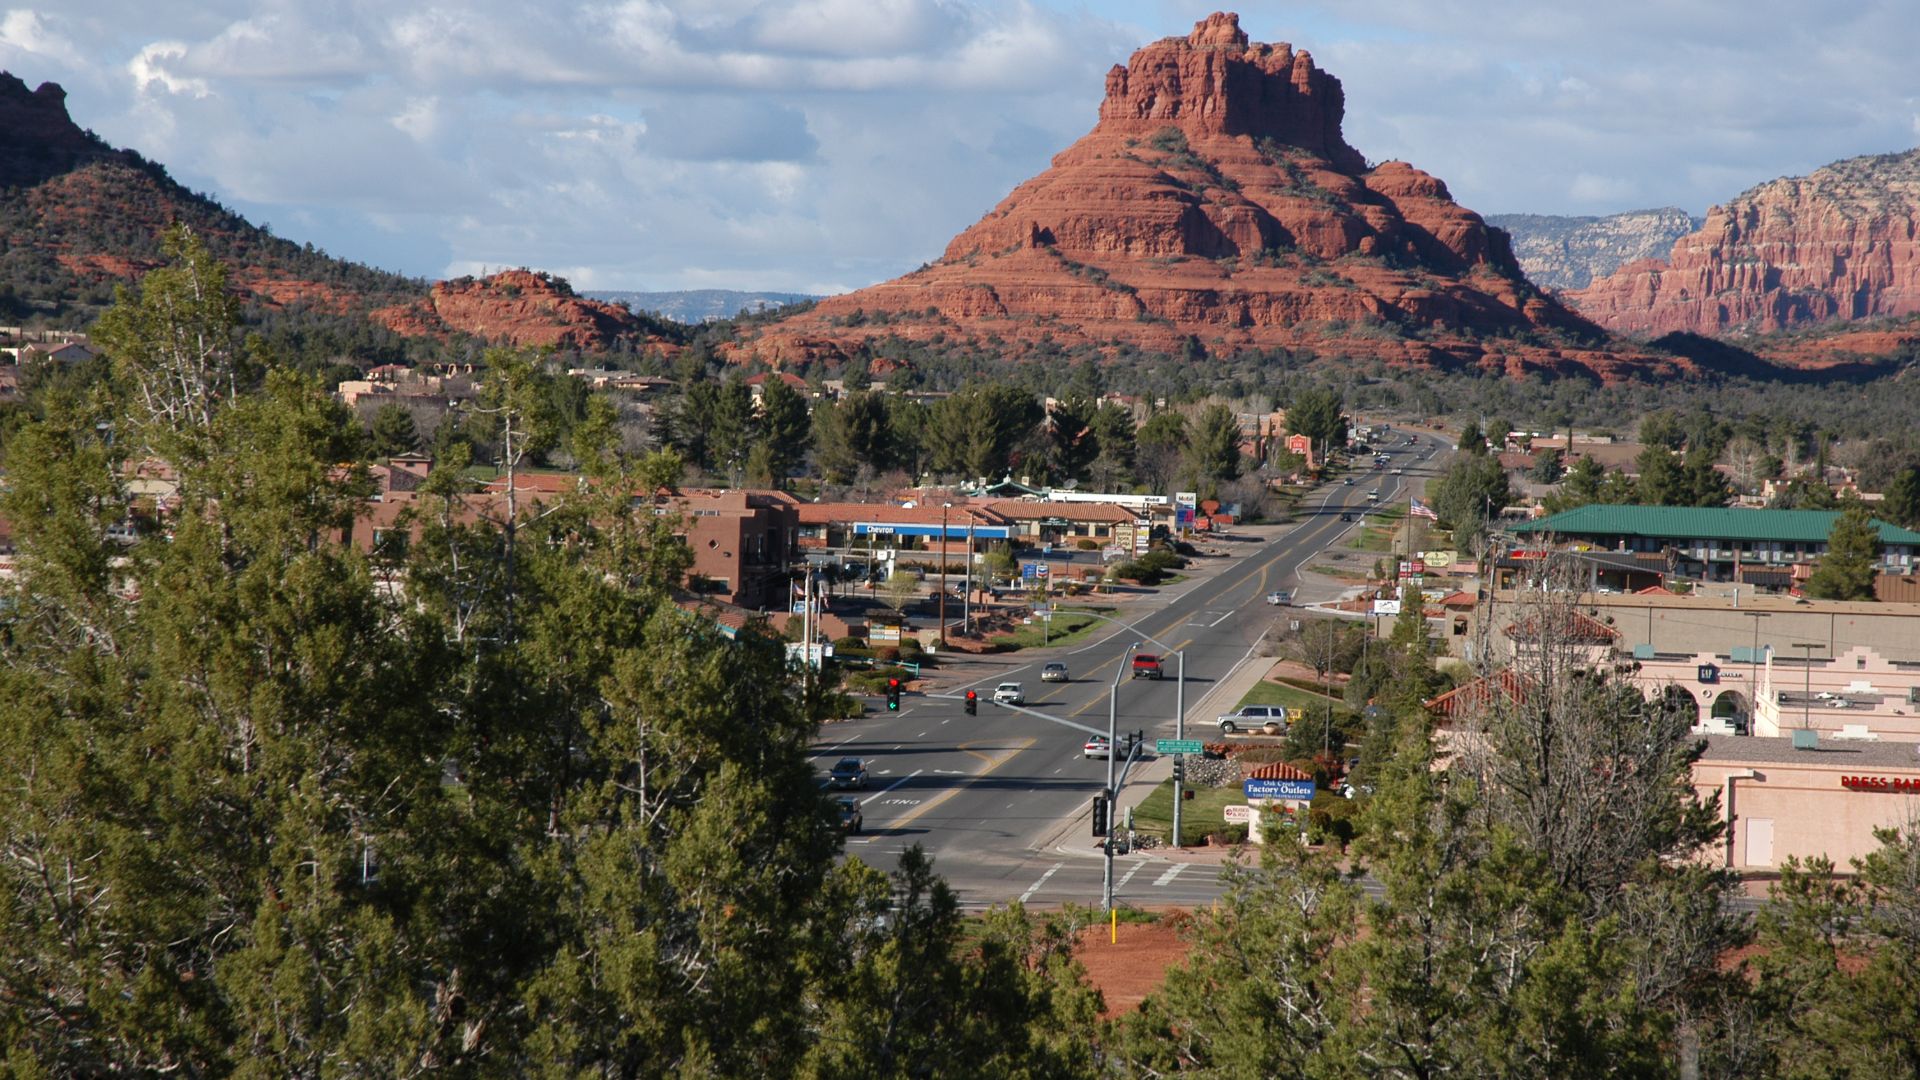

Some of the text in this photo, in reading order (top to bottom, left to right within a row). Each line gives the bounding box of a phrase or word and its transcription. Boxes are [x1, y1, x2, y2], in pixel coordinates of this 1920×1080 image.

[867, 526, 894, 534] Chevron
[1701, 669, 1713, 679] GAP
[1841, 775, 1888, 788] DRESS
[1248, 784, 1311, 794] Factory Outlets
